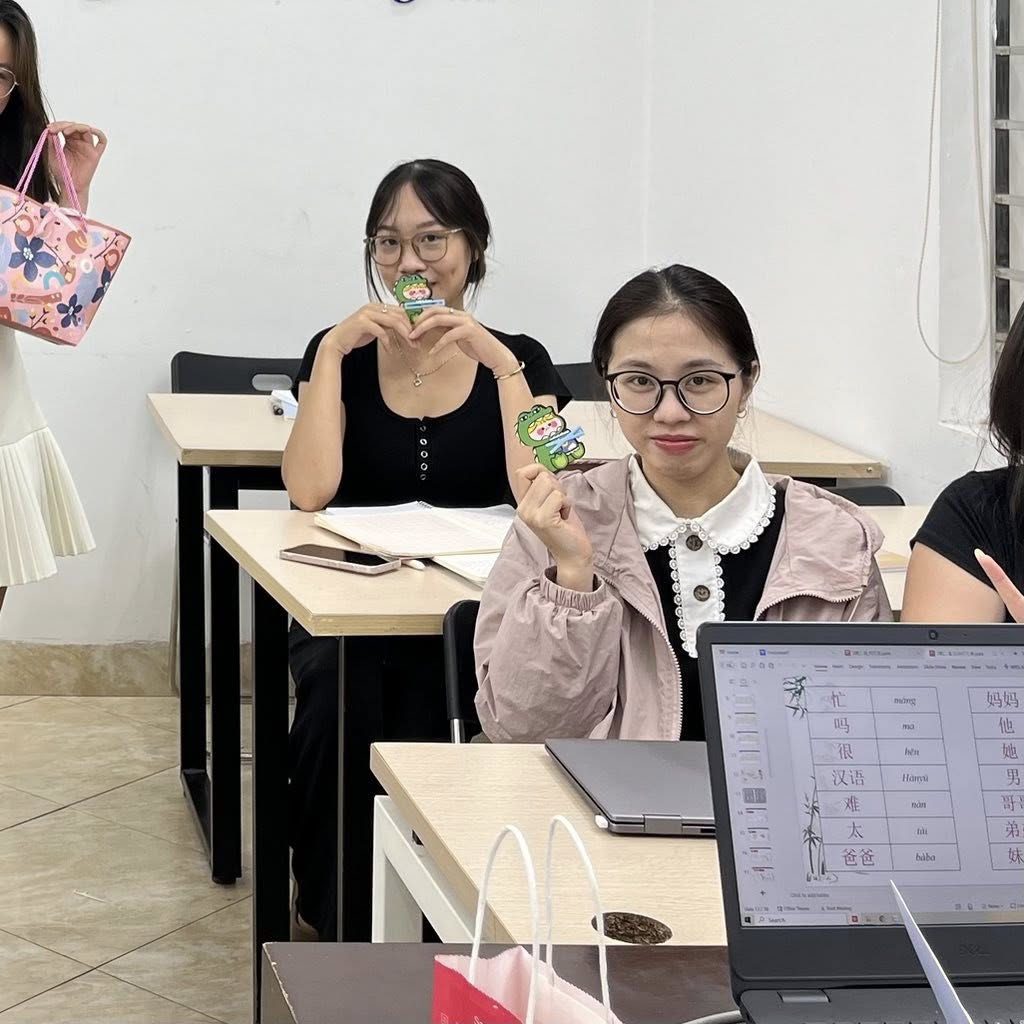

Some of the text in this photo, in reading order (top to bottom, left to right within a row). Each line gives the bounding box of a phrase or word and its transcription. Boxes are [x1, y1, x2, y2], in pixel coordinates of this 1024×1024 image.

[831, 690, 848, 708] 忙
[986, 691, 1020, 708] 妈妈
[833, 717, 850, 734] 吗
[998, 716, 1016, 735] 他
[837, 742, 854, 760] 很
[1002, 743, 1019, 760] 她
[831, 769, 865, 787] 汉语
[1005, 768, 1021, 786] 男
[844, 795, 861, 813] 难
[847, 821, 864, 839] 太
[1005, 820, 1024, 839] 弟
[841, 848, 875, 867] 爸爸
